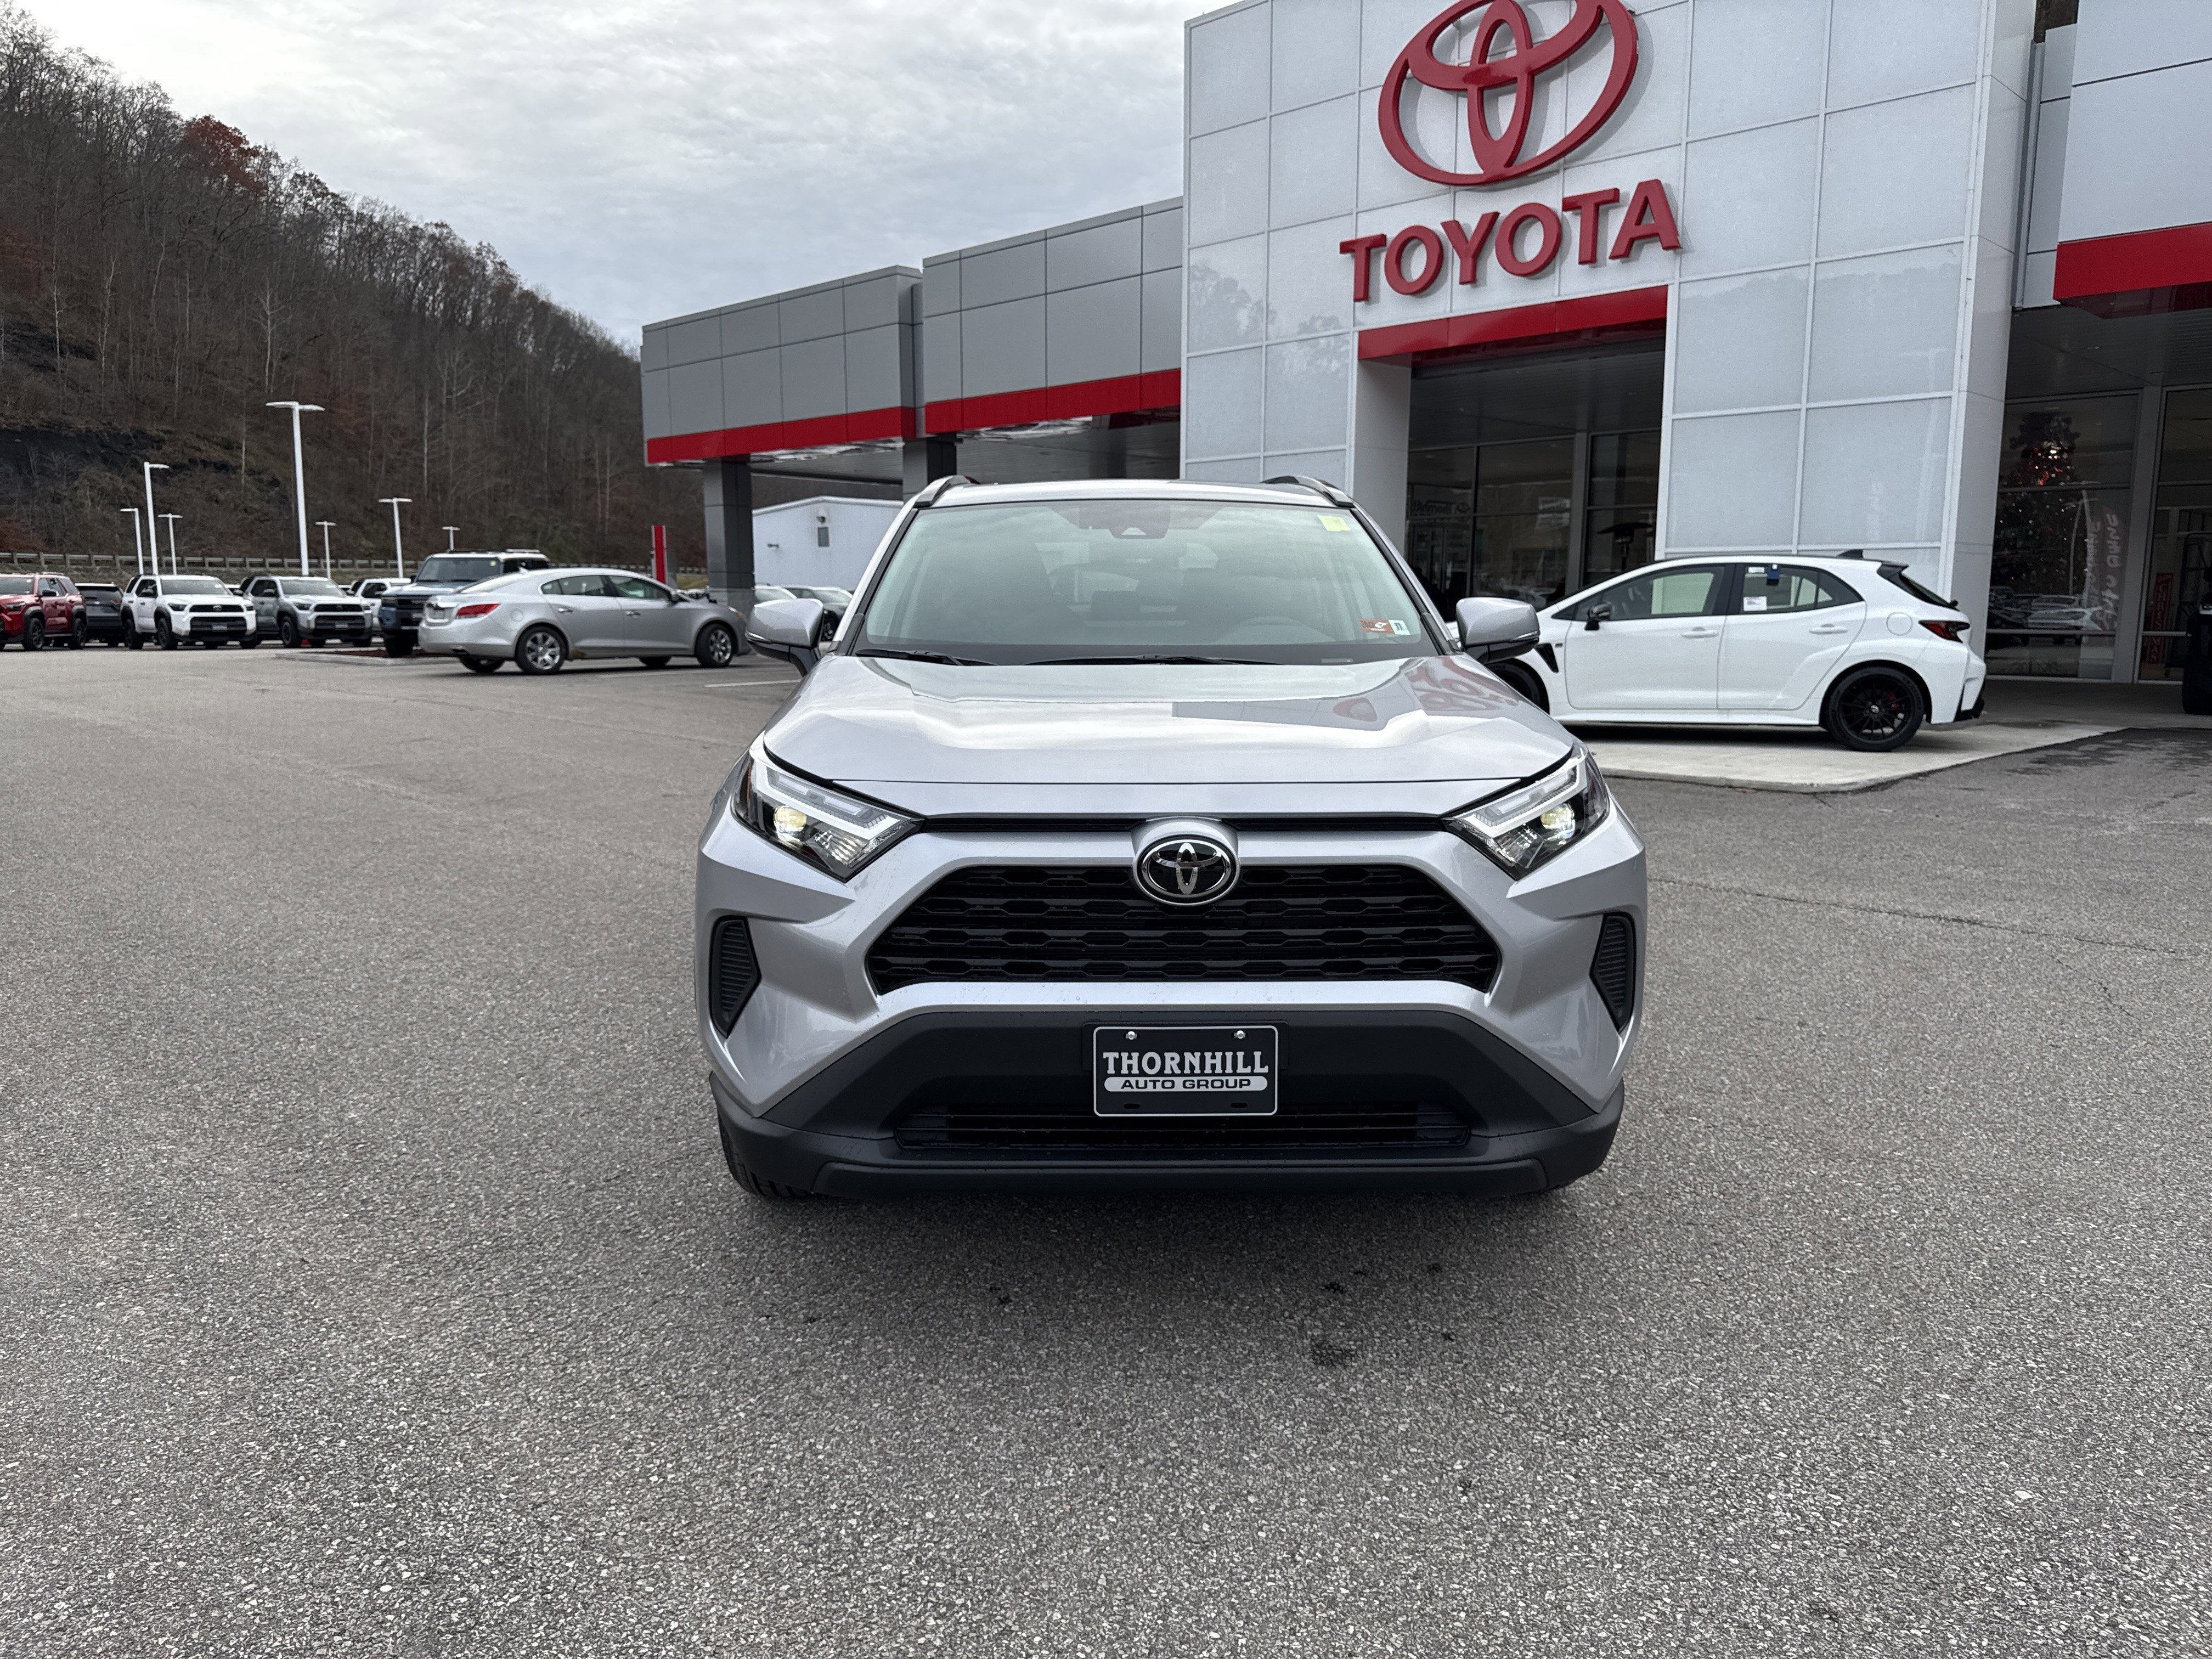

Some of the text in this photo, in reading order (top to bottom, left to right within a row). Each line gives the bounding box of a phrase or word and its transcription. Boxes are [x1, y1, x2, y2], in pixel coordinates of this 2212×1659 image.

[1340, 179, 1682, 302] TOYOTA
[2150, 583, 2168, 662] CHRISMAS
[1103, 1051, 1268, 1075] THORNHILL
[1120, 1078, 1251, 1090] AUTO GROUP
